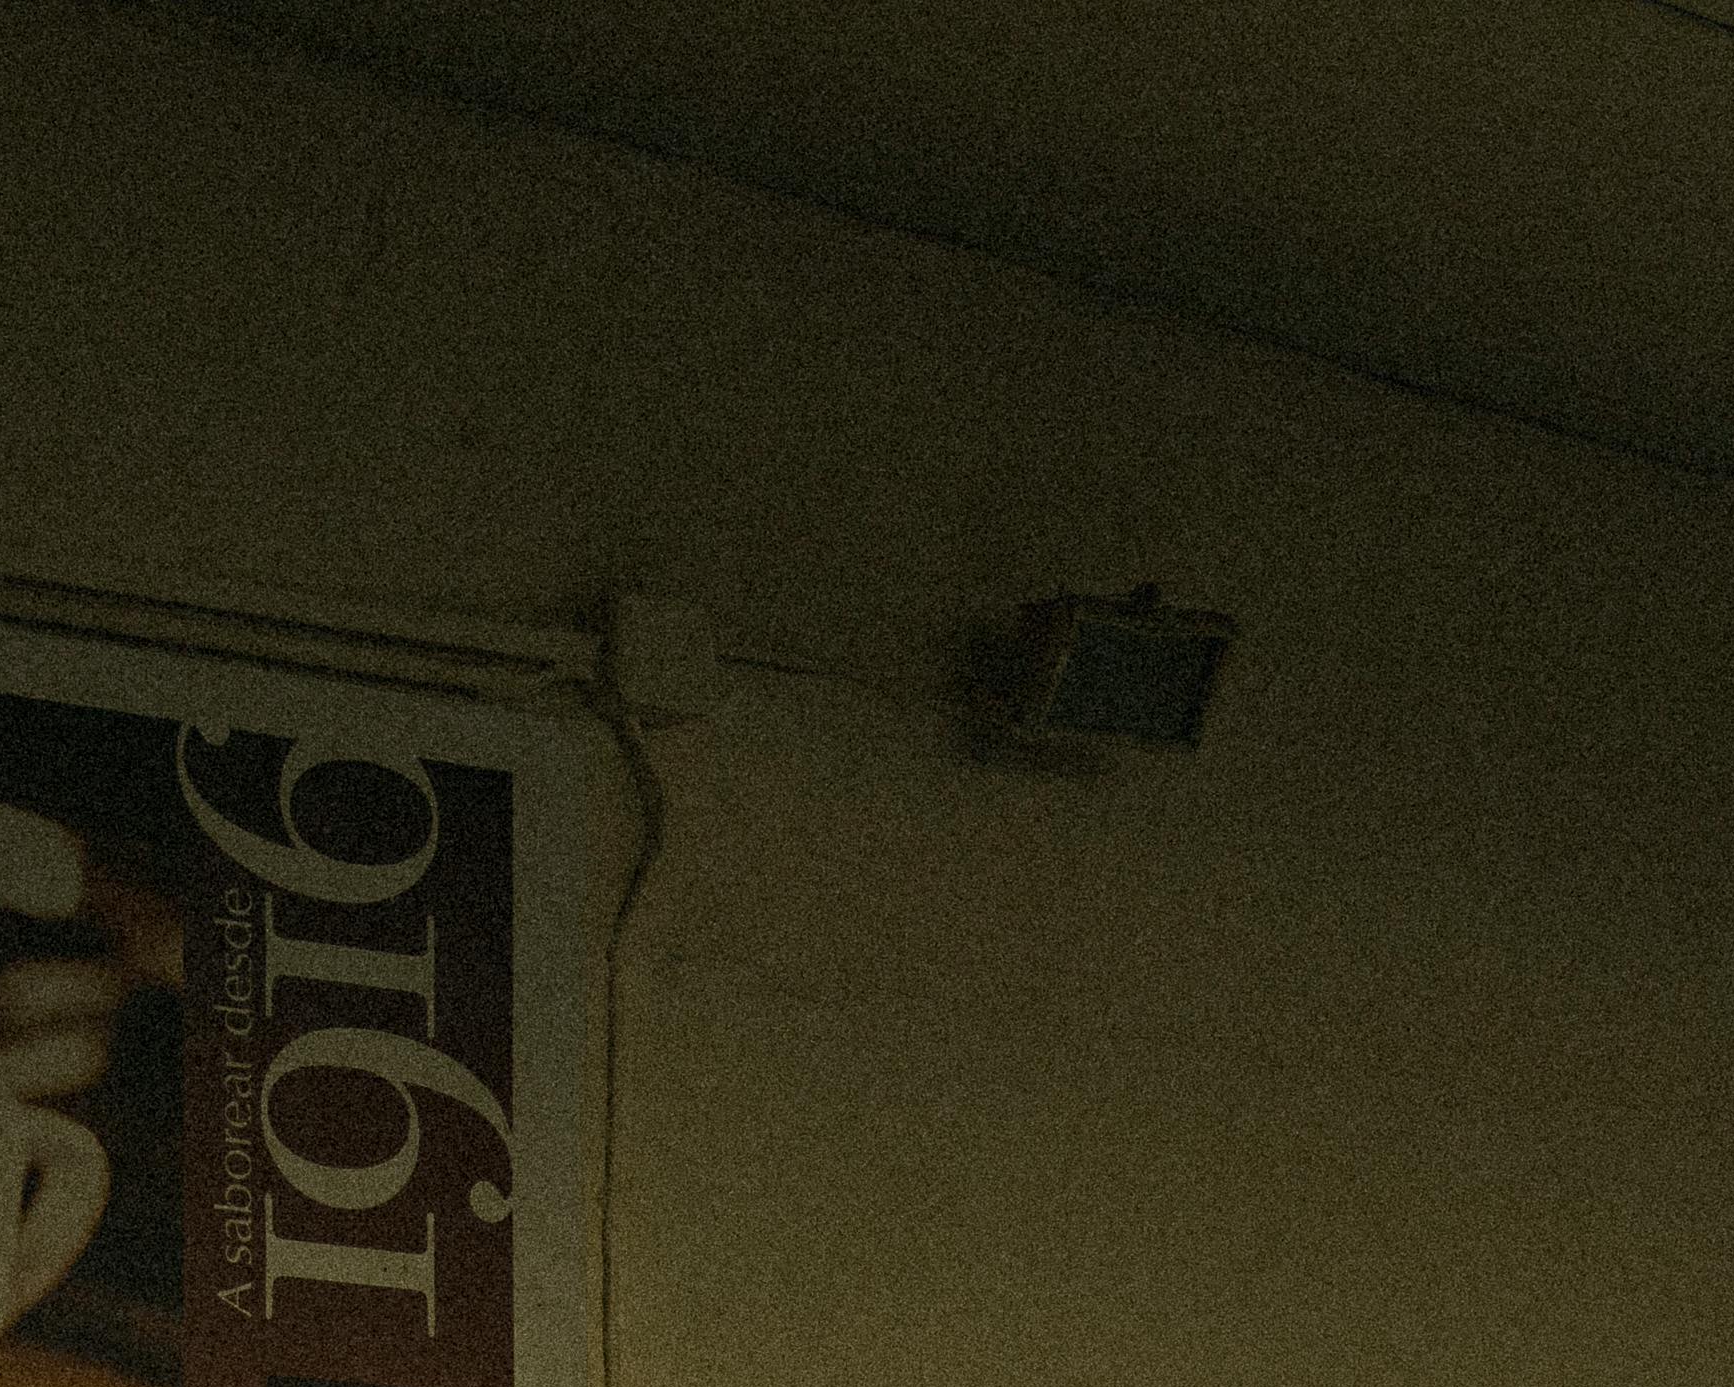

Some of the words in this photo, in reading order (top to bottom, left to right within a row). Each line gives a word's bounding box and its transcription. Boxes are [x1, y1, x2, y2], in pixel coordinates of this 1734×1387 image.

[176, 718, 514, 1339] 1916
[213, 887, 255, 1037] desde
[213, 1056, 255, 1268] saborear
[216, 1280, 255, 1319] A
